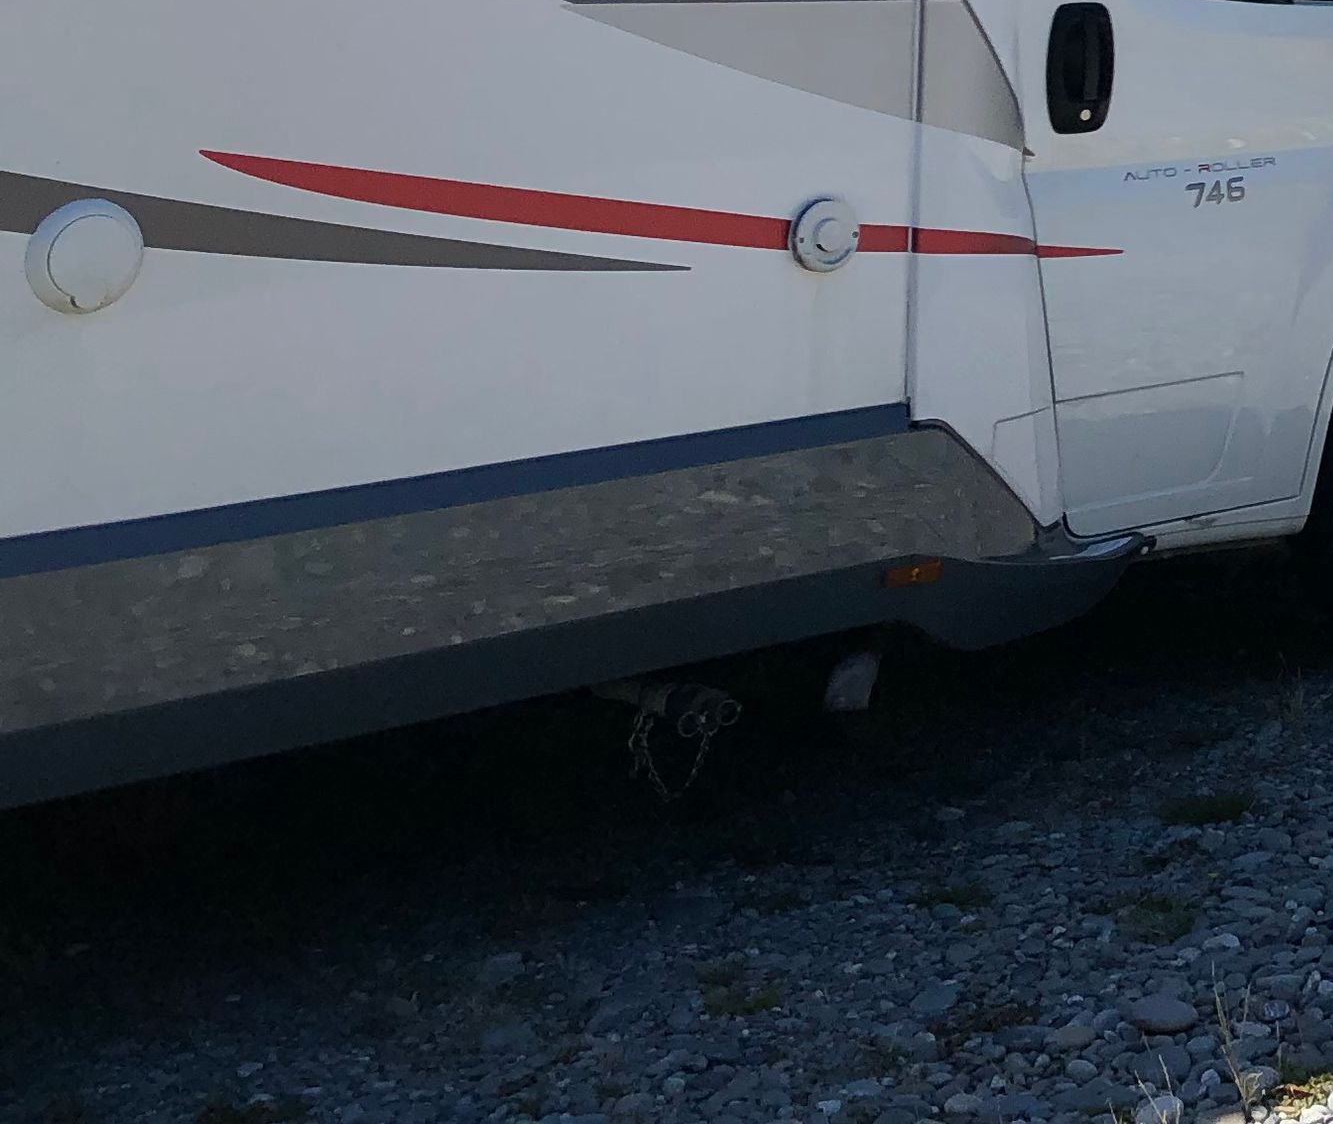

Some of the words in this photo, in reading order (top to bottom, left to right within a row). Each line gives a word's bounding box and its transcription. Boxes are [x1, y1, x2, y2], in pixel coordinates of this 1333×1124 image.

[1123, 167, 1177, 182] AUTO
[1198, 156, 1276, 174] ROLLER
[1185, 176, 1245, 208] 746
